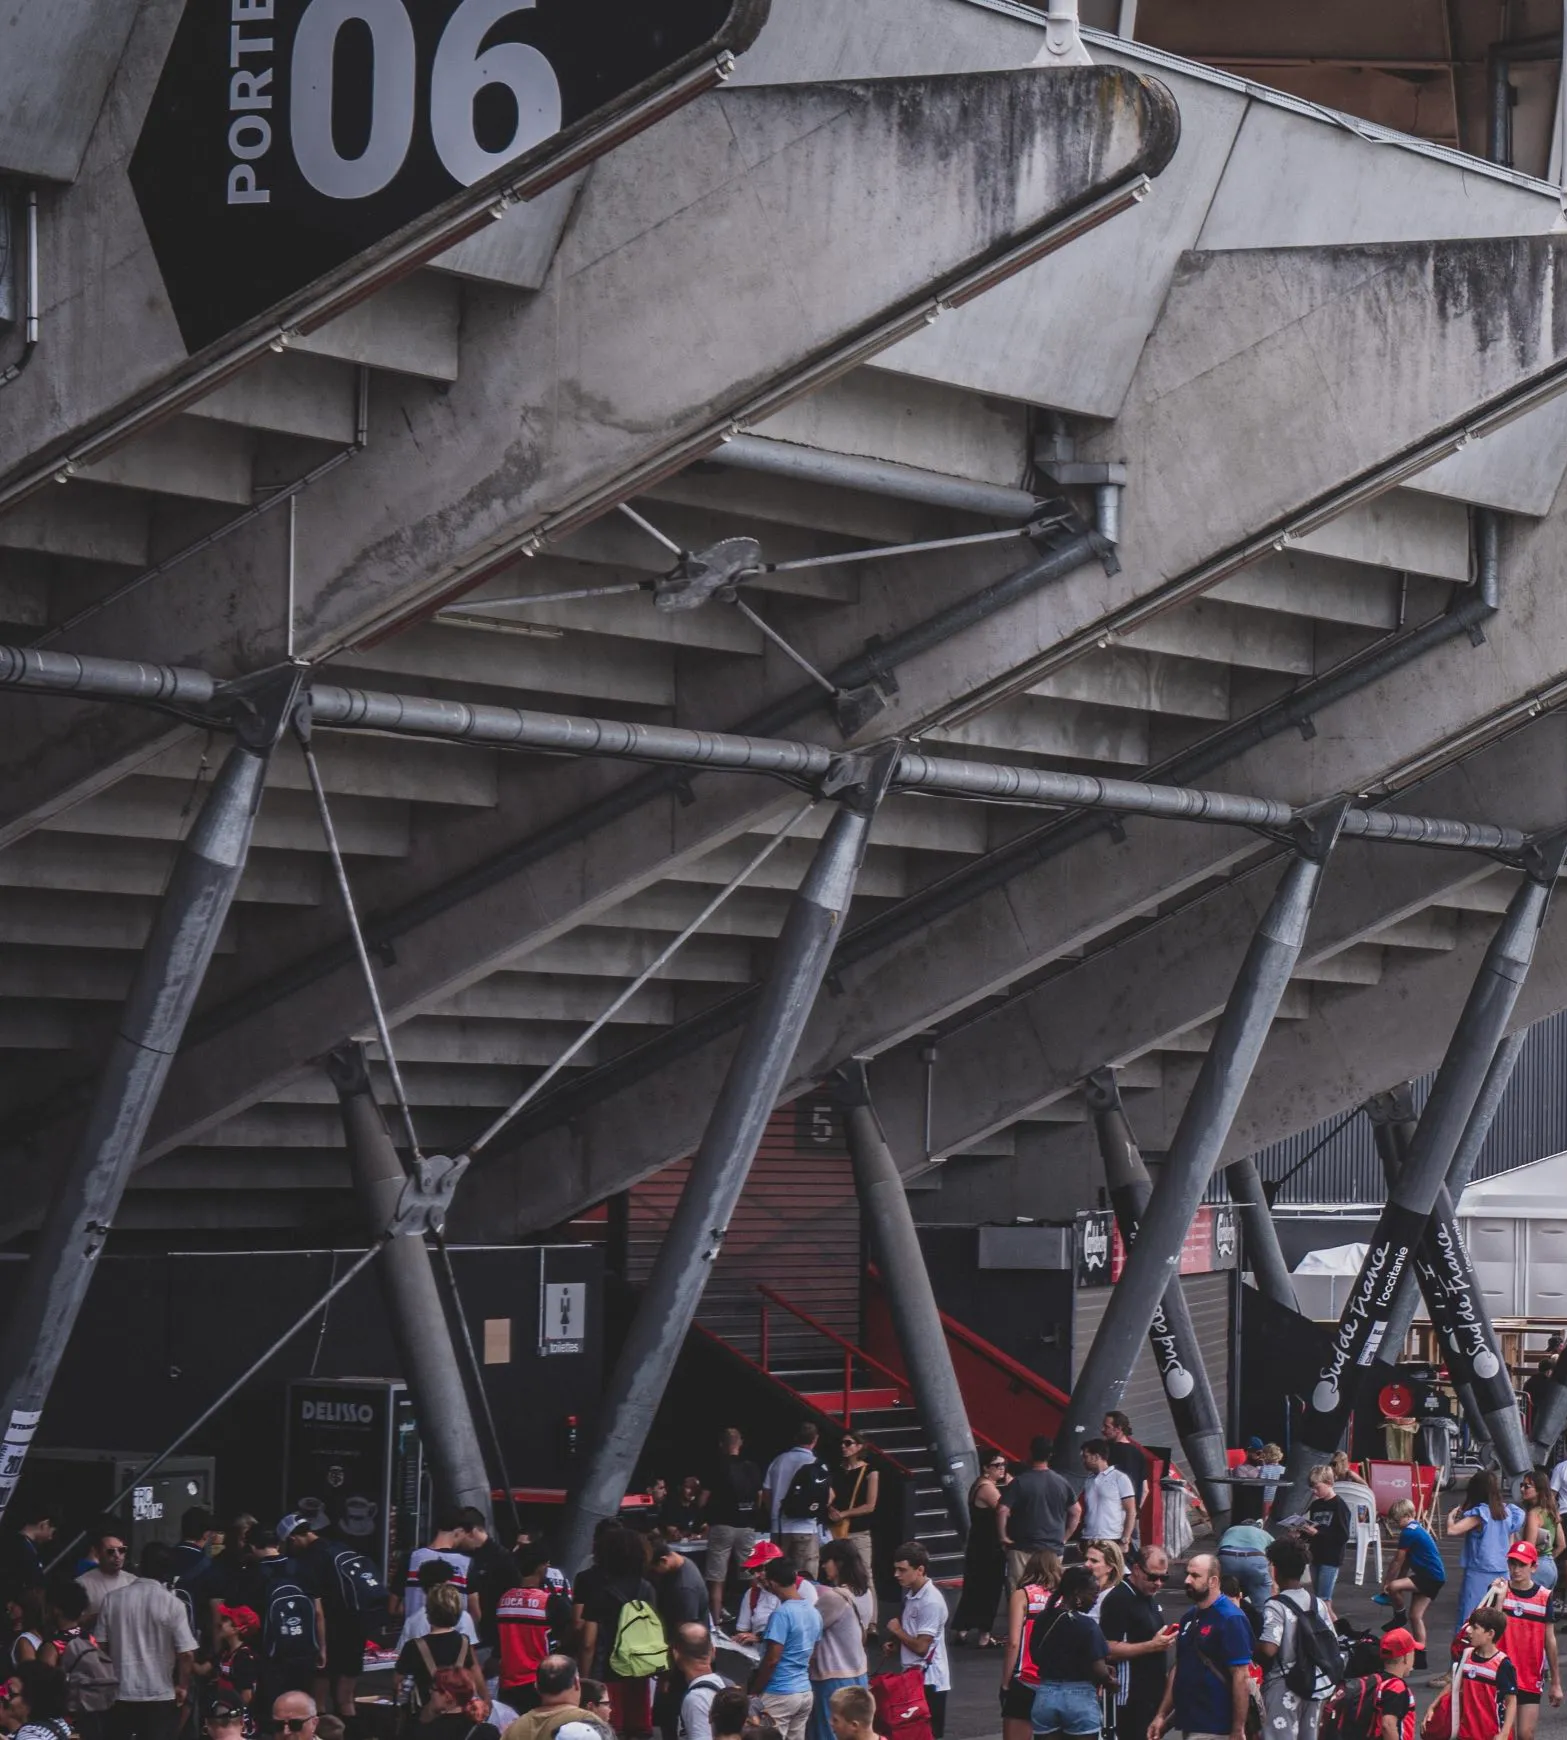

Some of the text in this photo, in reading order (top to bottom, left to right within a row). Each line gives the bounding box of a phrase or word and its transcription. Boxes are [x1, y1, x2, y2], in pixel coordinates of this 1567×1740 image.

[227, 0, 275, 204] PORTE
[291, 0, 562, 199] 06
[1346, 1241, 1390, 1318] France
[1376, 1246, 1409, 1307] l'occitanie
[1338, 1318, 1359, 1349] de
[1320, 1341, 1351, 1393] Sud
[302, 1400, 374, 1423] DELISSO
